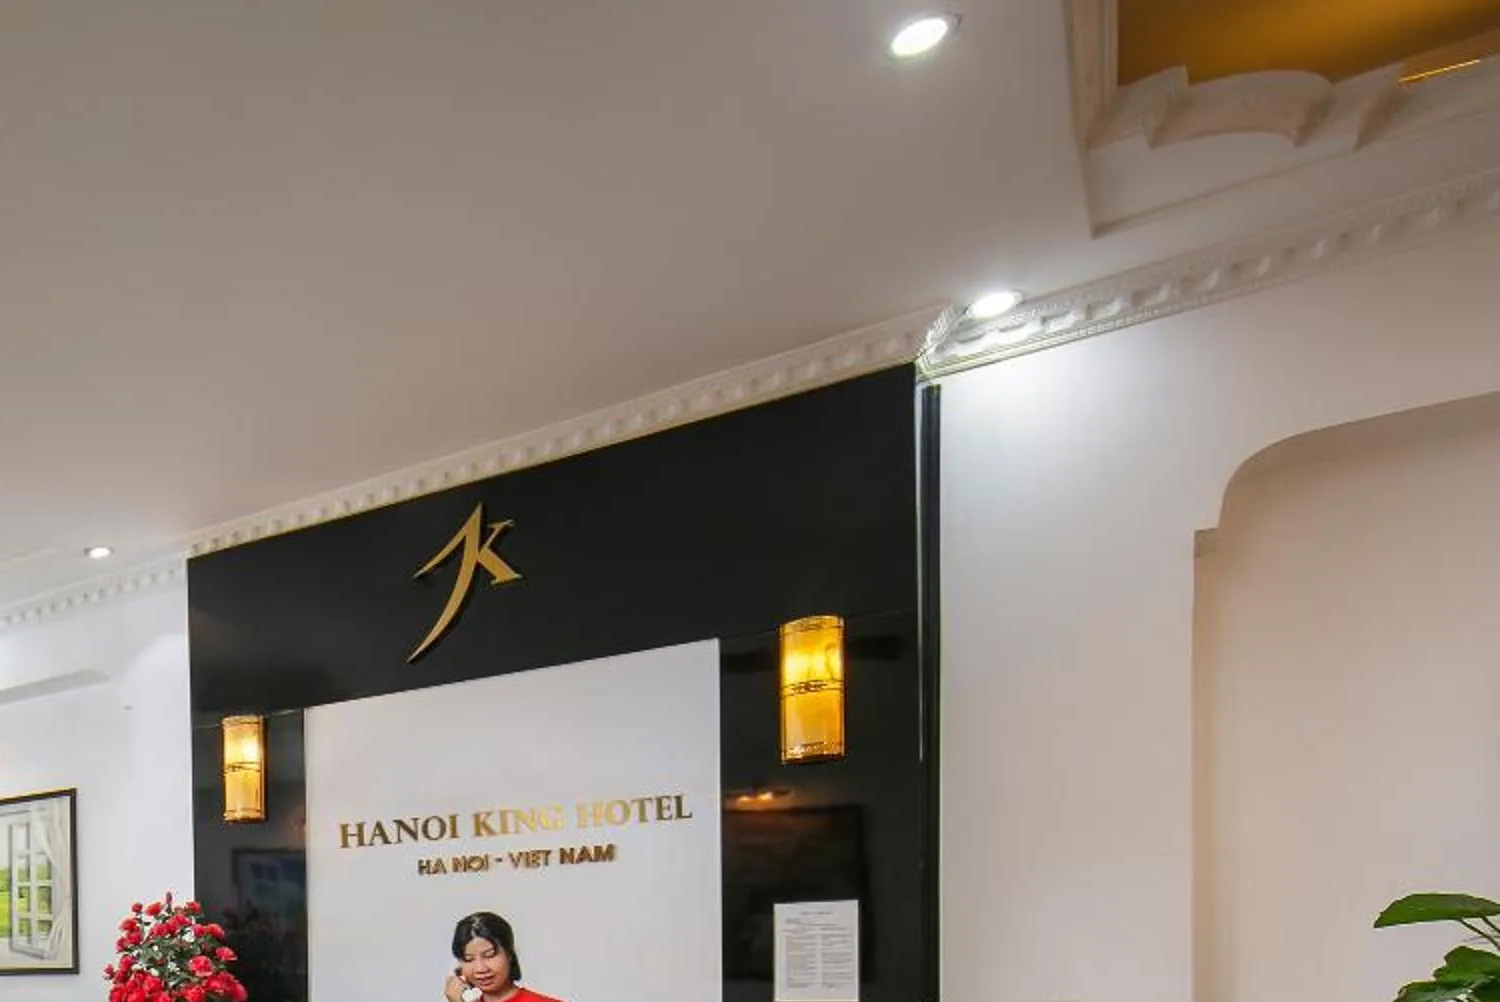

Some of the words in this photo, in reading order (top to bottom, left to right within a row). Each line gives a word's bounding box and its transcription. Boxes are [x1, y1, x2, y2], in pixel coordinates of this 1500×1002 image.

[339, 813, 459, 849] HANOI
[473, 805, 564, 838] KING
[576, 794, 693, 830] HOTEL
[418, 856, 447, 876] HA
[452, 854, 490, 873] NOI
[509, 849, 552, 870] VIET
[559, 843, 617, 865] NAM
